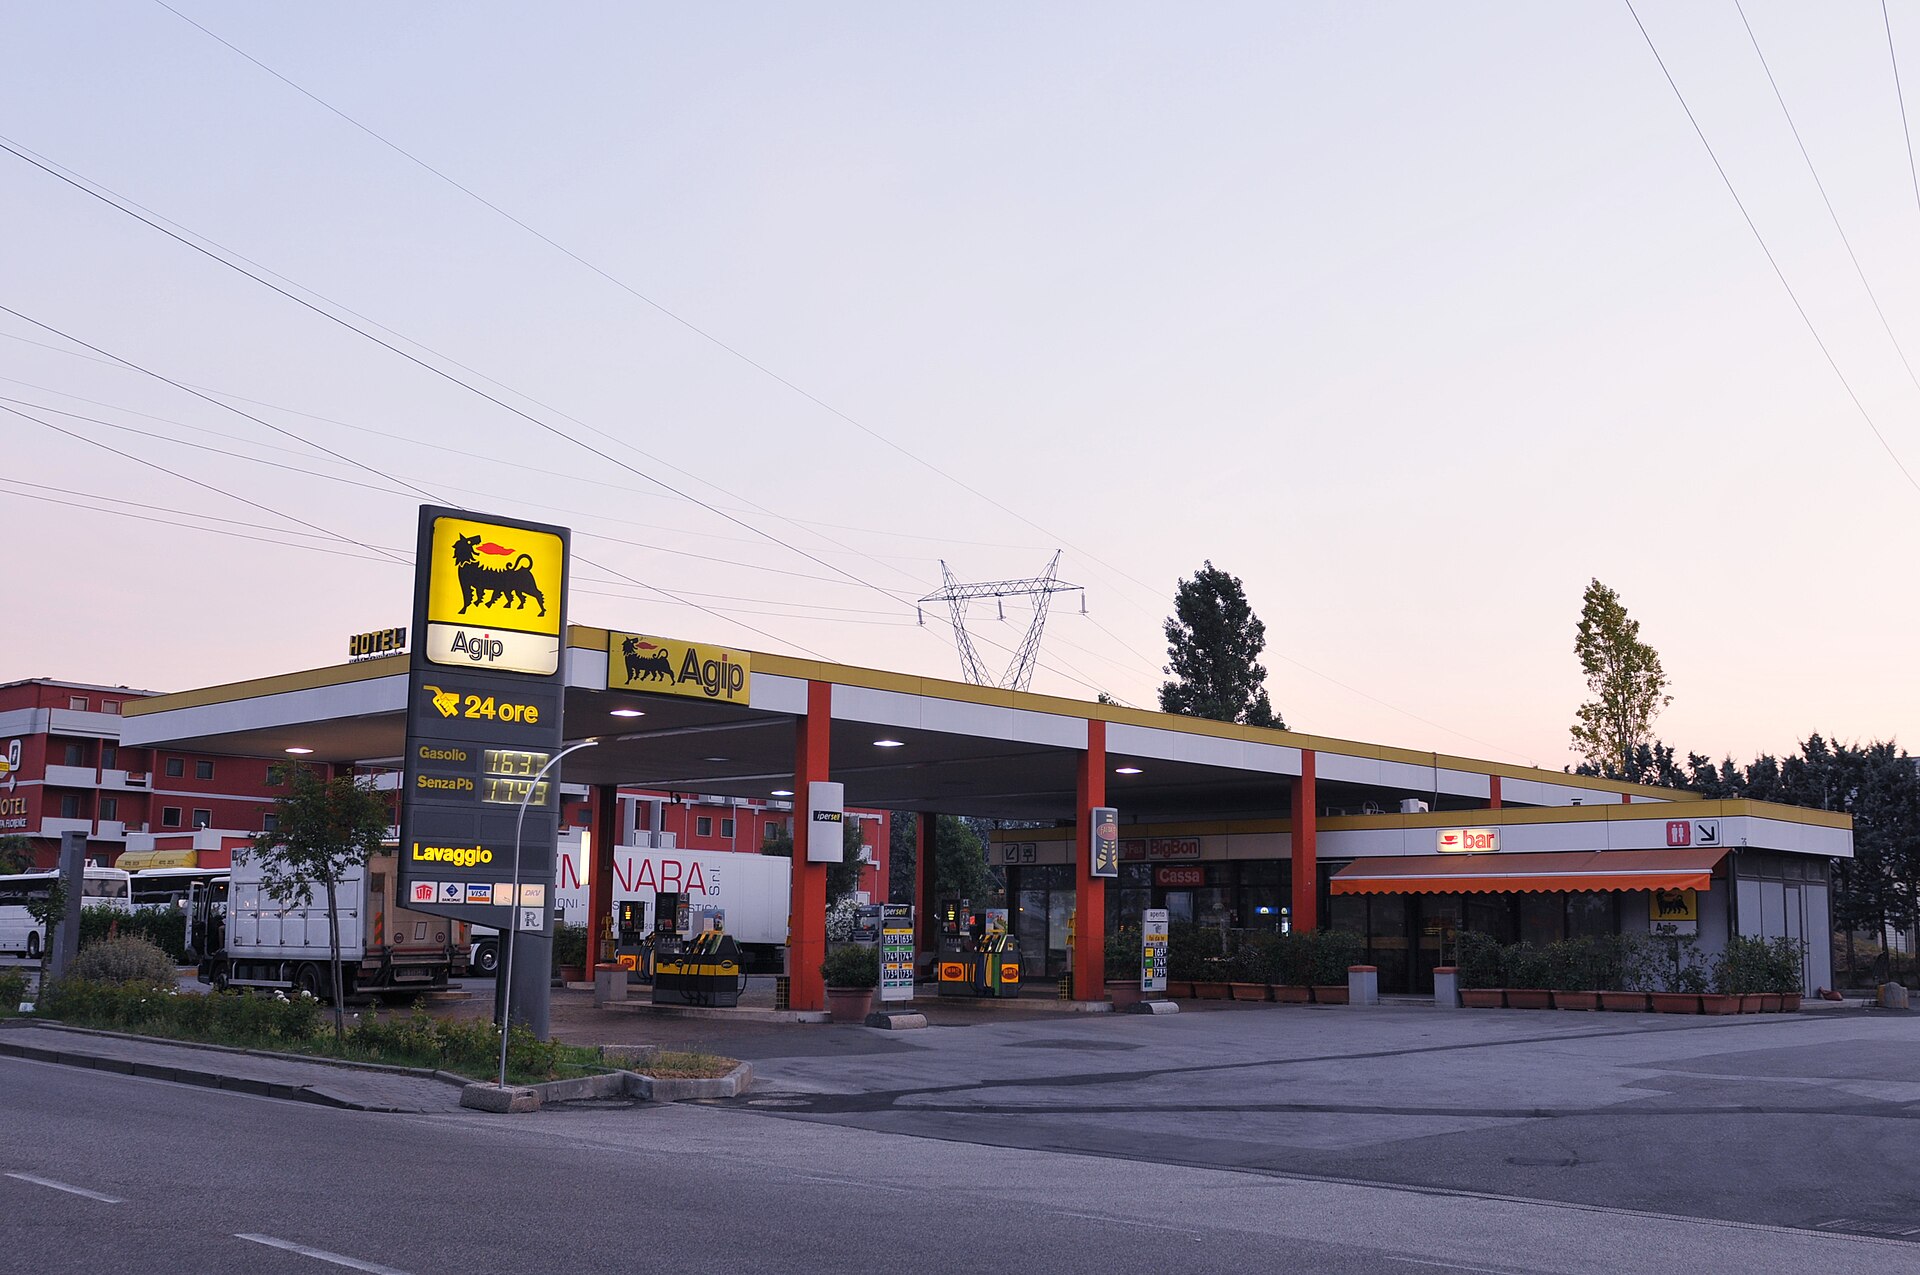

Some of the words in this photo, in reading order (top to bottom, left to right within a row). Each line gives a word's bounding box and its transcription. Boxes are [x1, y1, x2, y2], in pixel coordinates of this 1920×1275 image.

[349, 627, 405, 656] HOTEL
[450, 630, 504, 662] Agip
[677, 647, 744, 699] Agip
[464, 695, 496, 720] 24
[498, 703, 539, 724] ore
[418, 746, 467, 762] Gasolio
[0, 798, 27, 816] OTEL
[1463, 829, 1495, 849] bar
[412, 843, 493, 868] Lavaggio
[1150, 839, 1197, 858] BigBon
[1159, 868, 1200, 883] Cassa
[415, 884, 434, 901] UTA
[525, 889, 541, 897] DKV
[884, 907, 908, 918] iperself
[1149, 911, 1165, 919] aperto
